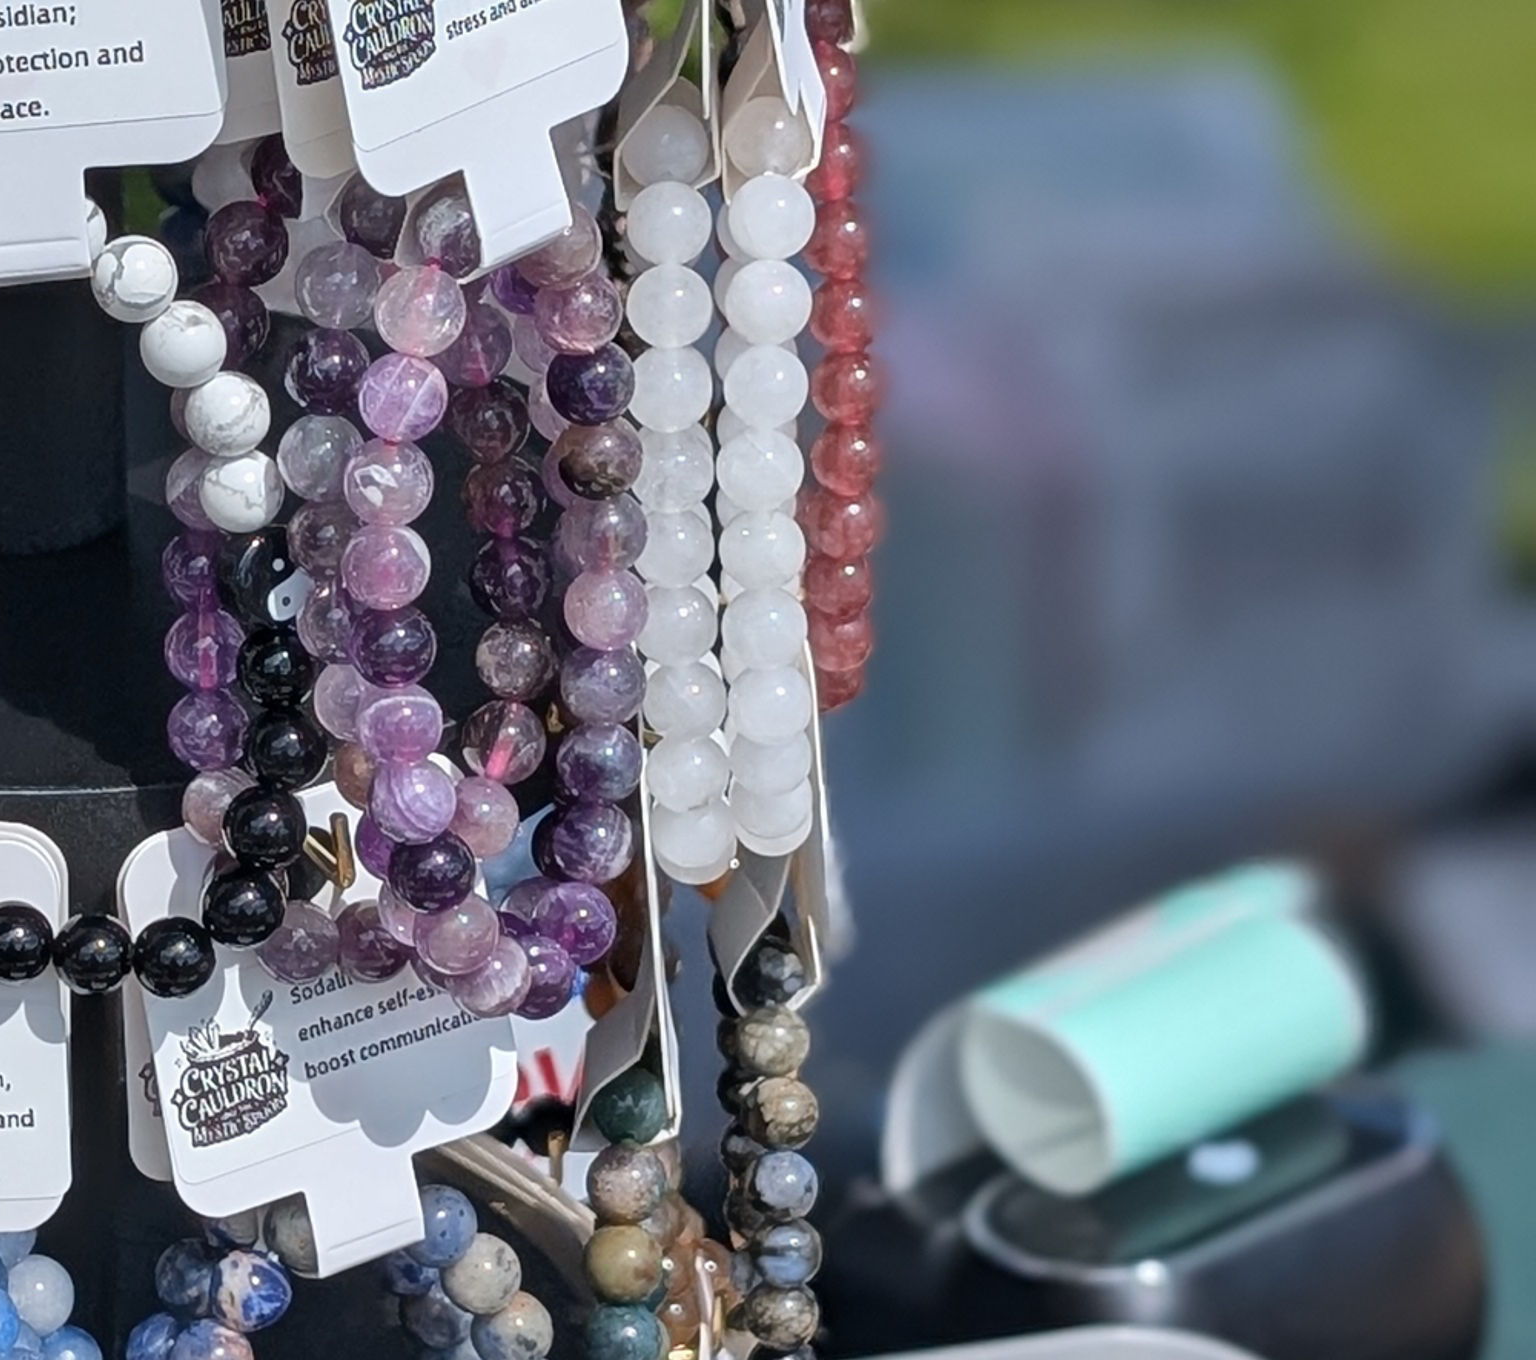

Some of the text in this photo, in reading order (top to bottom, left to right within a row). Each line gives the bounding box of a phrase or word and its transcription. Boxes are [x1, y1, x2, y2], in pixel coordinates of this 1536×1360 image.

[445, 9, 488, 41] stress
[97, 40, 145, 66] and
[298, 1005, 374, 1041] enhance
[305, 1009, 482, 1080] boost communicati
